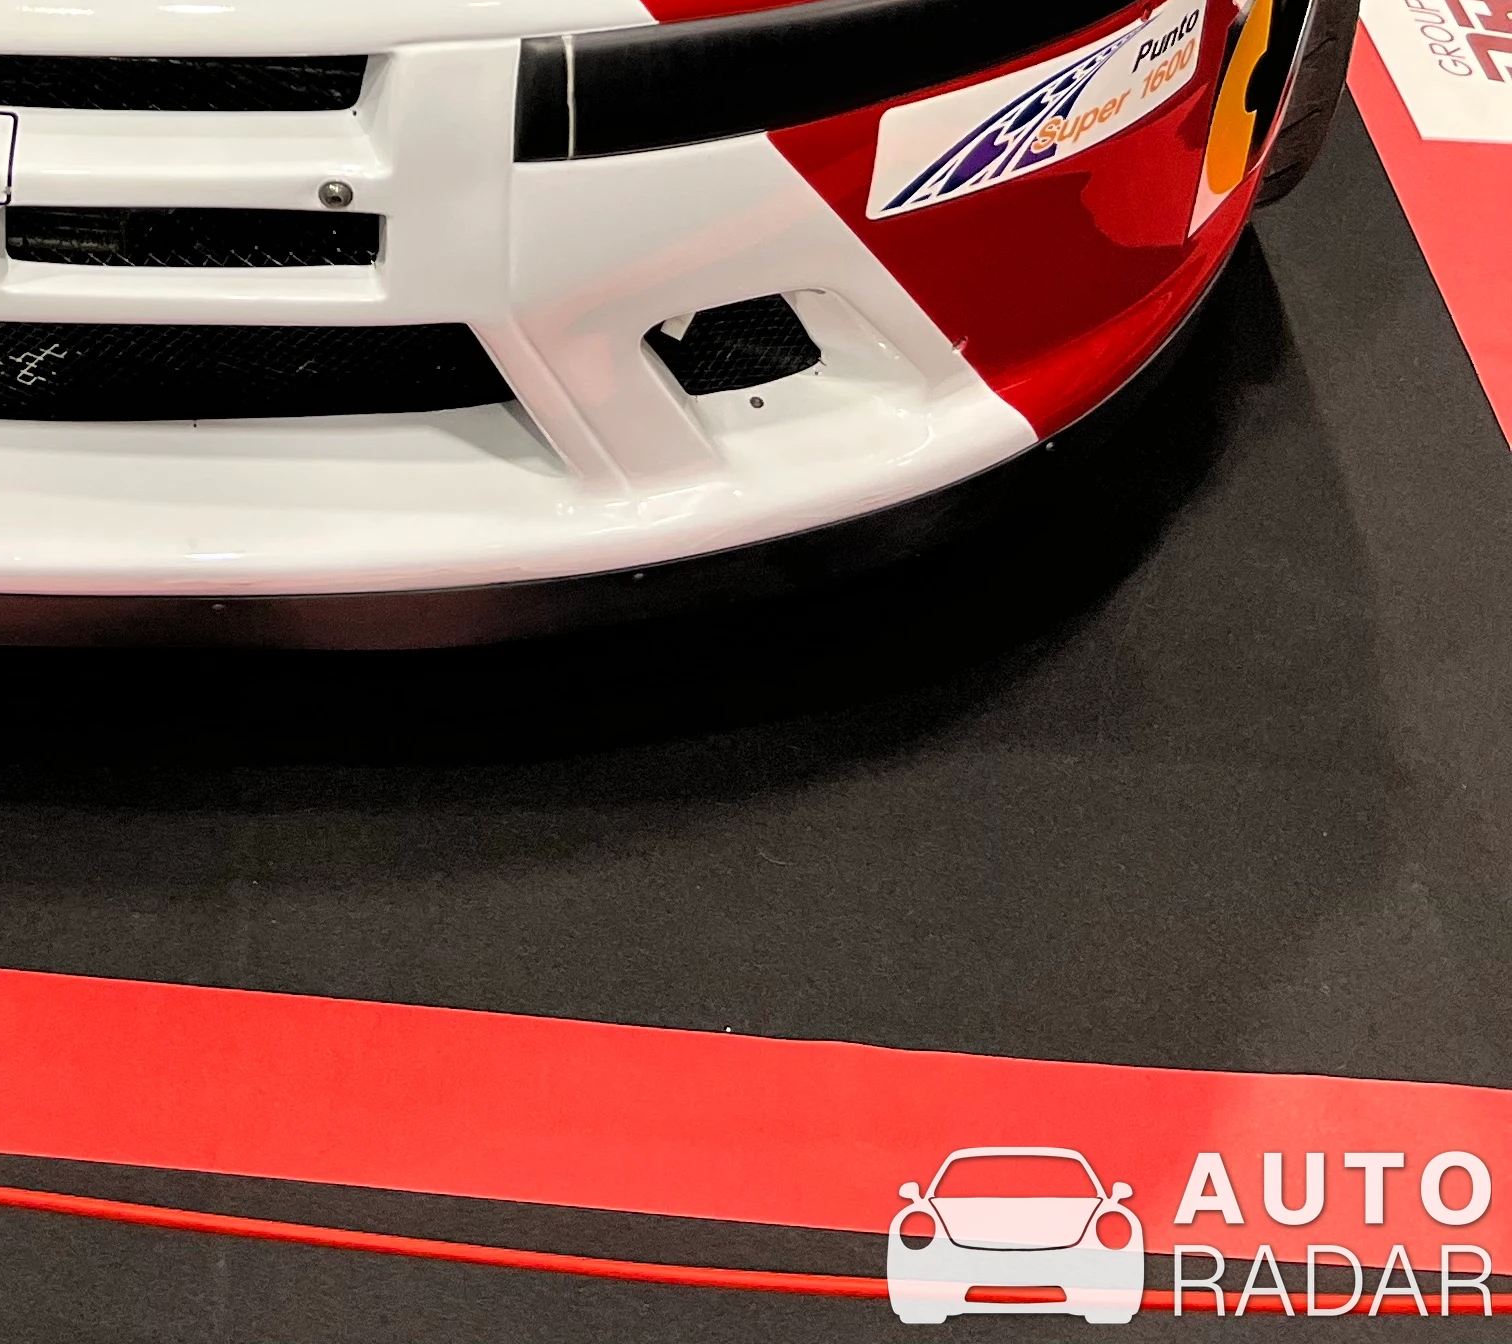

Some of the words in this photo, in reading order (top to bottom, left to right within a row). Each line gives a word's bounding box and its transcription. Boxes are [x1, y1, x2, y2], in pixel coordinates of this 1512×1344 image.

[1131, 8, 1199, 74] Punto
[1030, 88, 1132, 154] Super
[1140, 37, 1196, 100] 1600
